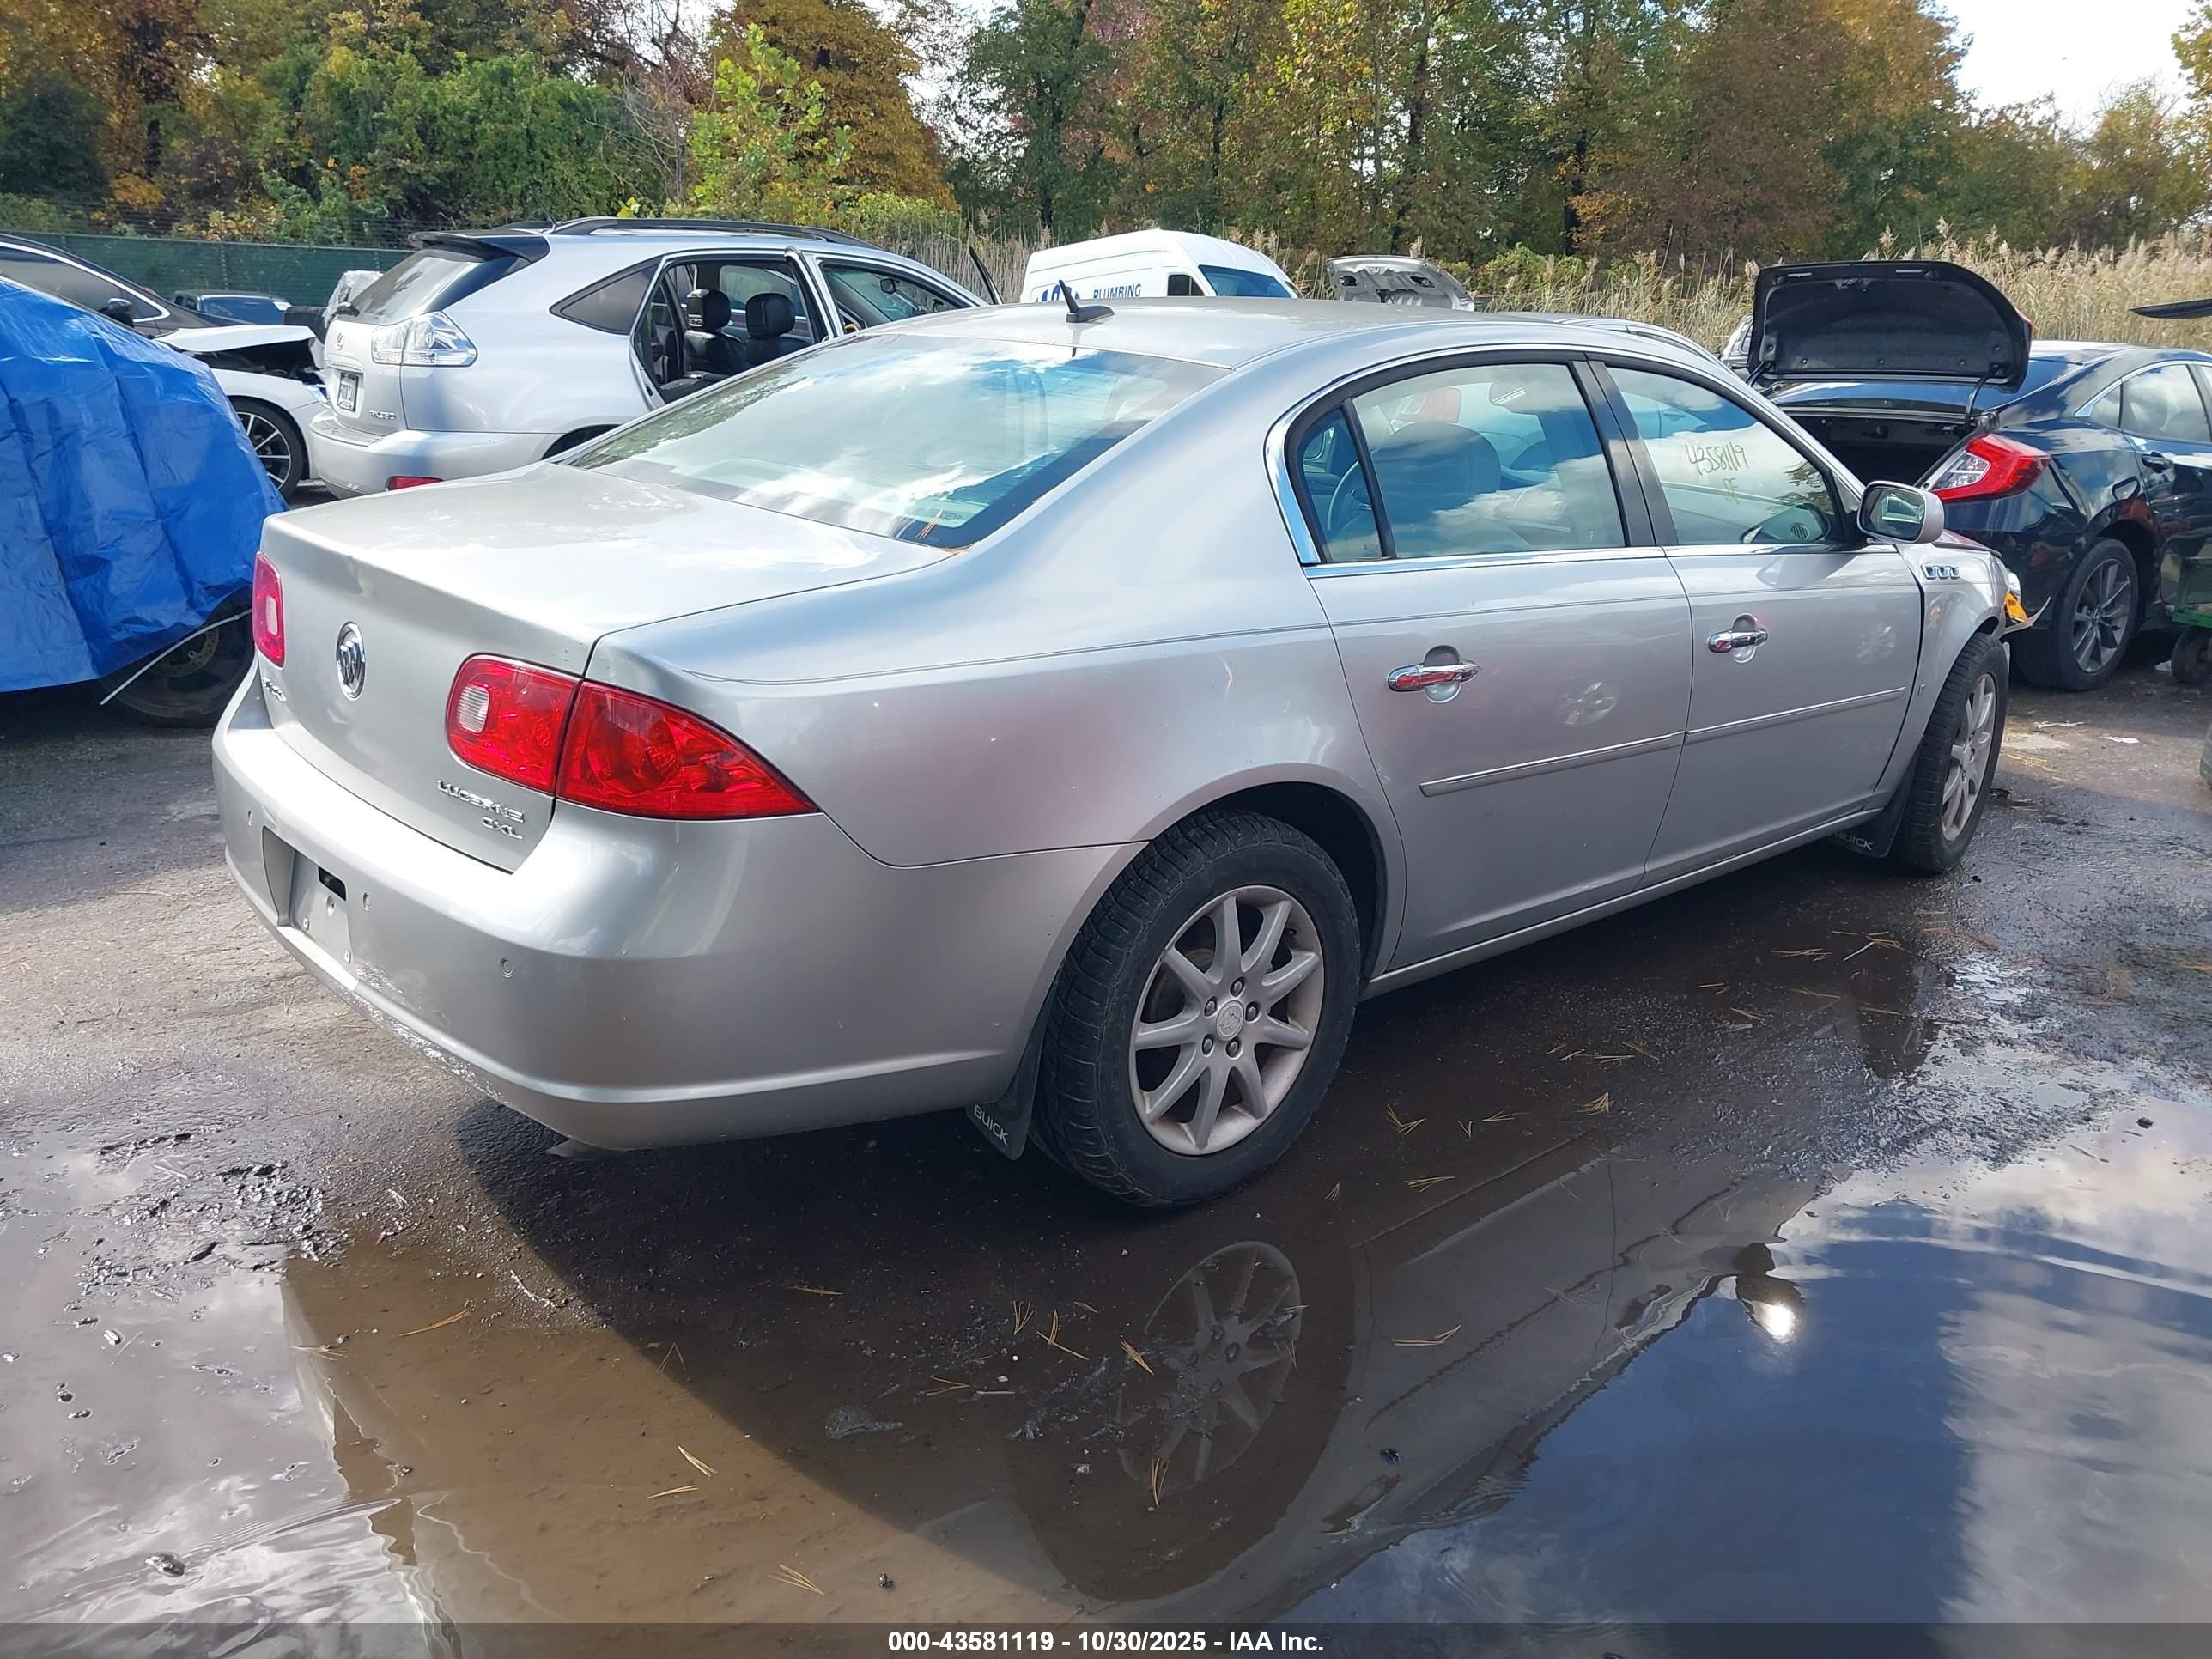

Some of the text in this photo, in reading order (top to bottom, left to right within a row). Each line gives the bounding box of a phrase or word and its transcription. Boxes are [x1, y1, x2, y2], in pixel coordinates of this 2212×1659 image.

[1093, 283, 1141, 299] PLUMBING
[1684, 441, 1749, 476] 43581119
[481, 817, 523, 840] CXL
[974, 1104, 1009, 1146] BUICK
